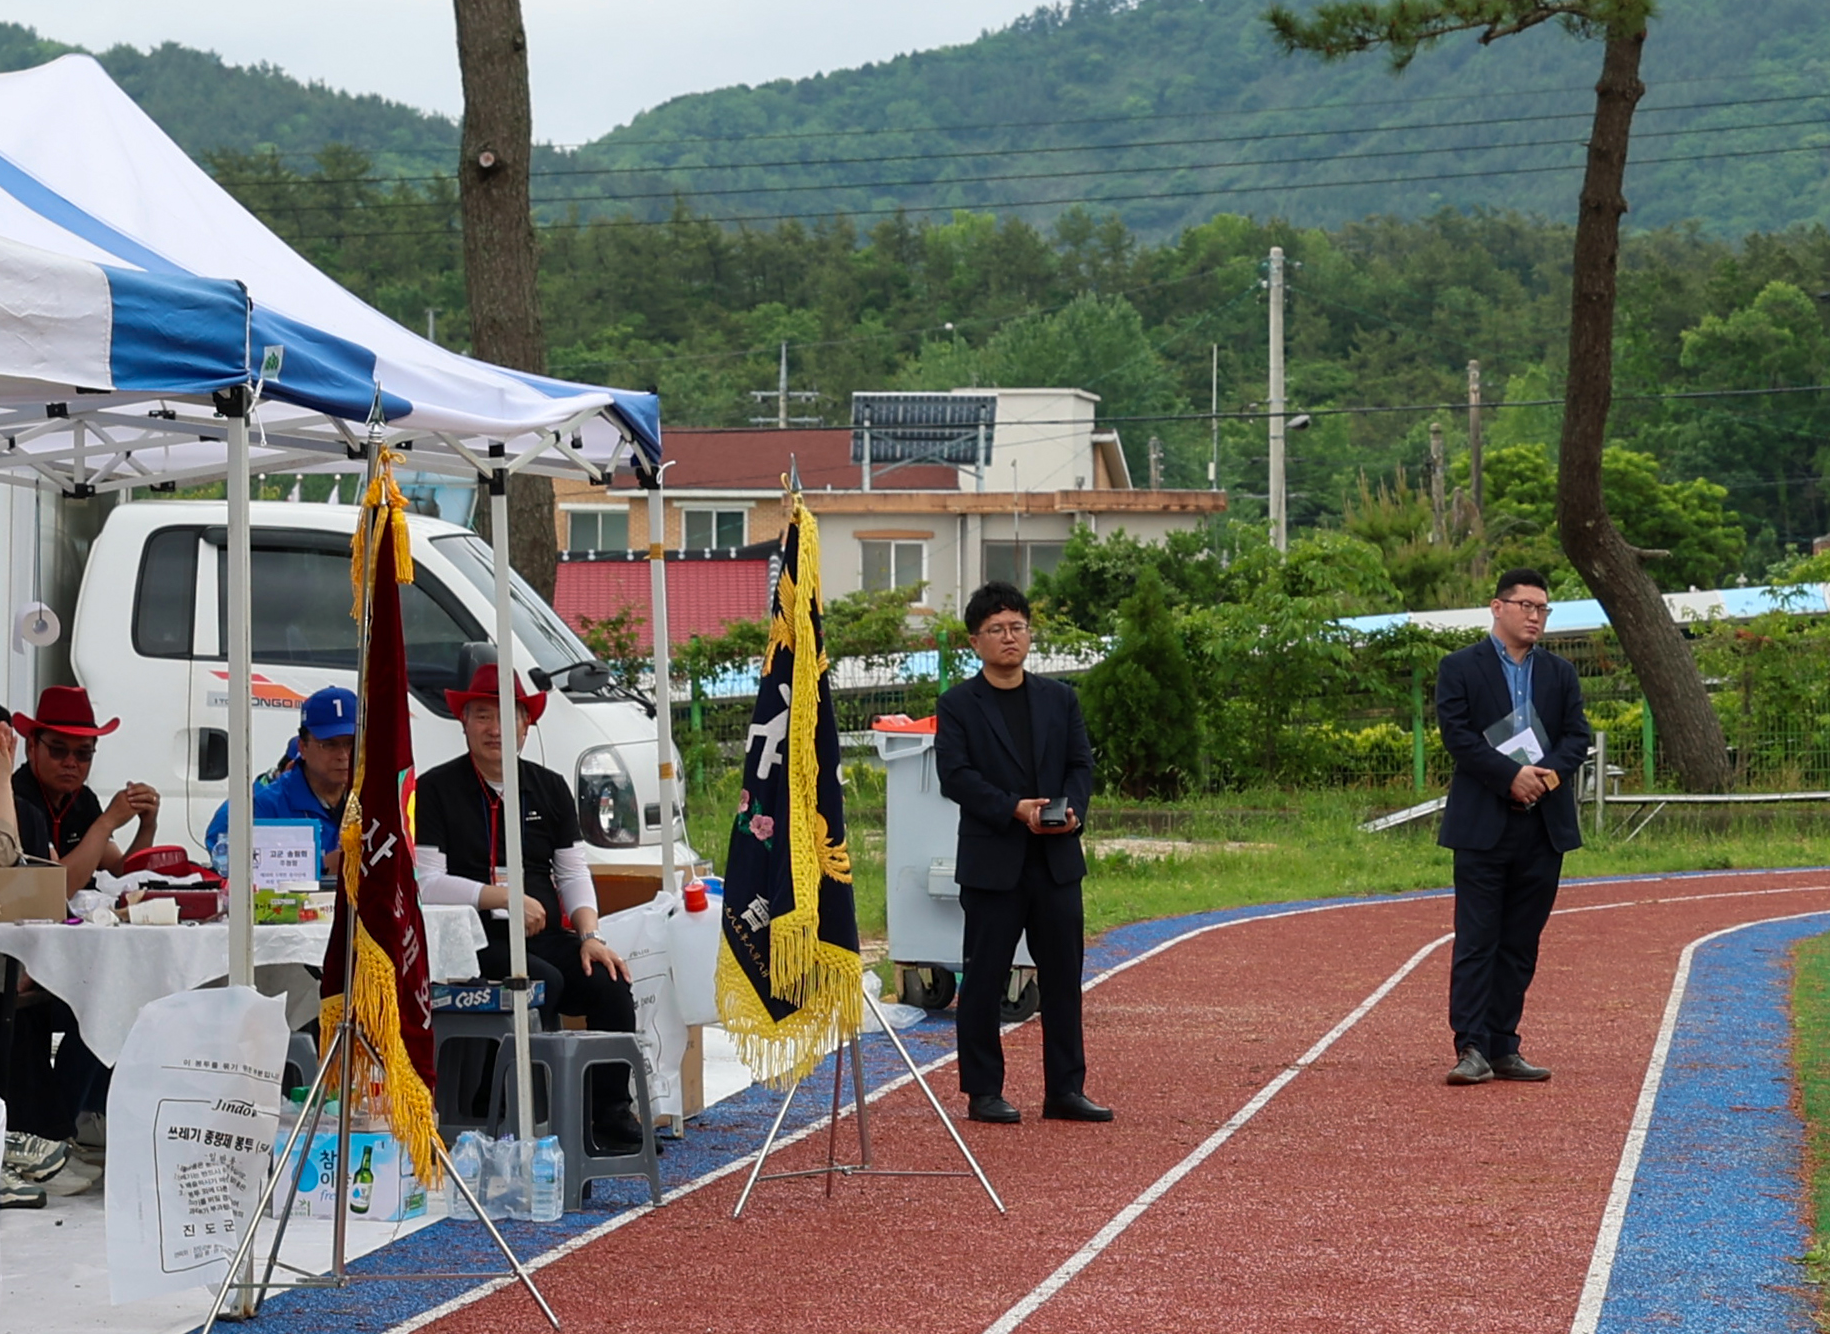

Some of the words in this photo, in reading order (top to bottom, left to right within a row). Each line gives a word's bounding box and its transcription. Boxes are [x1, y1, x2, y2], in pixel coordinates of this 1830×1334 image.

[251, 696, 293, 709] ONGO
[332, 699, 344, 717] 1
[167, 1126, 202, 1142] 쓰레기
[204, 1129, 233, 1149] 종량제
[234, 1135, 254, 1153] 봉투
[320, 1150, 338, 1169] 참
